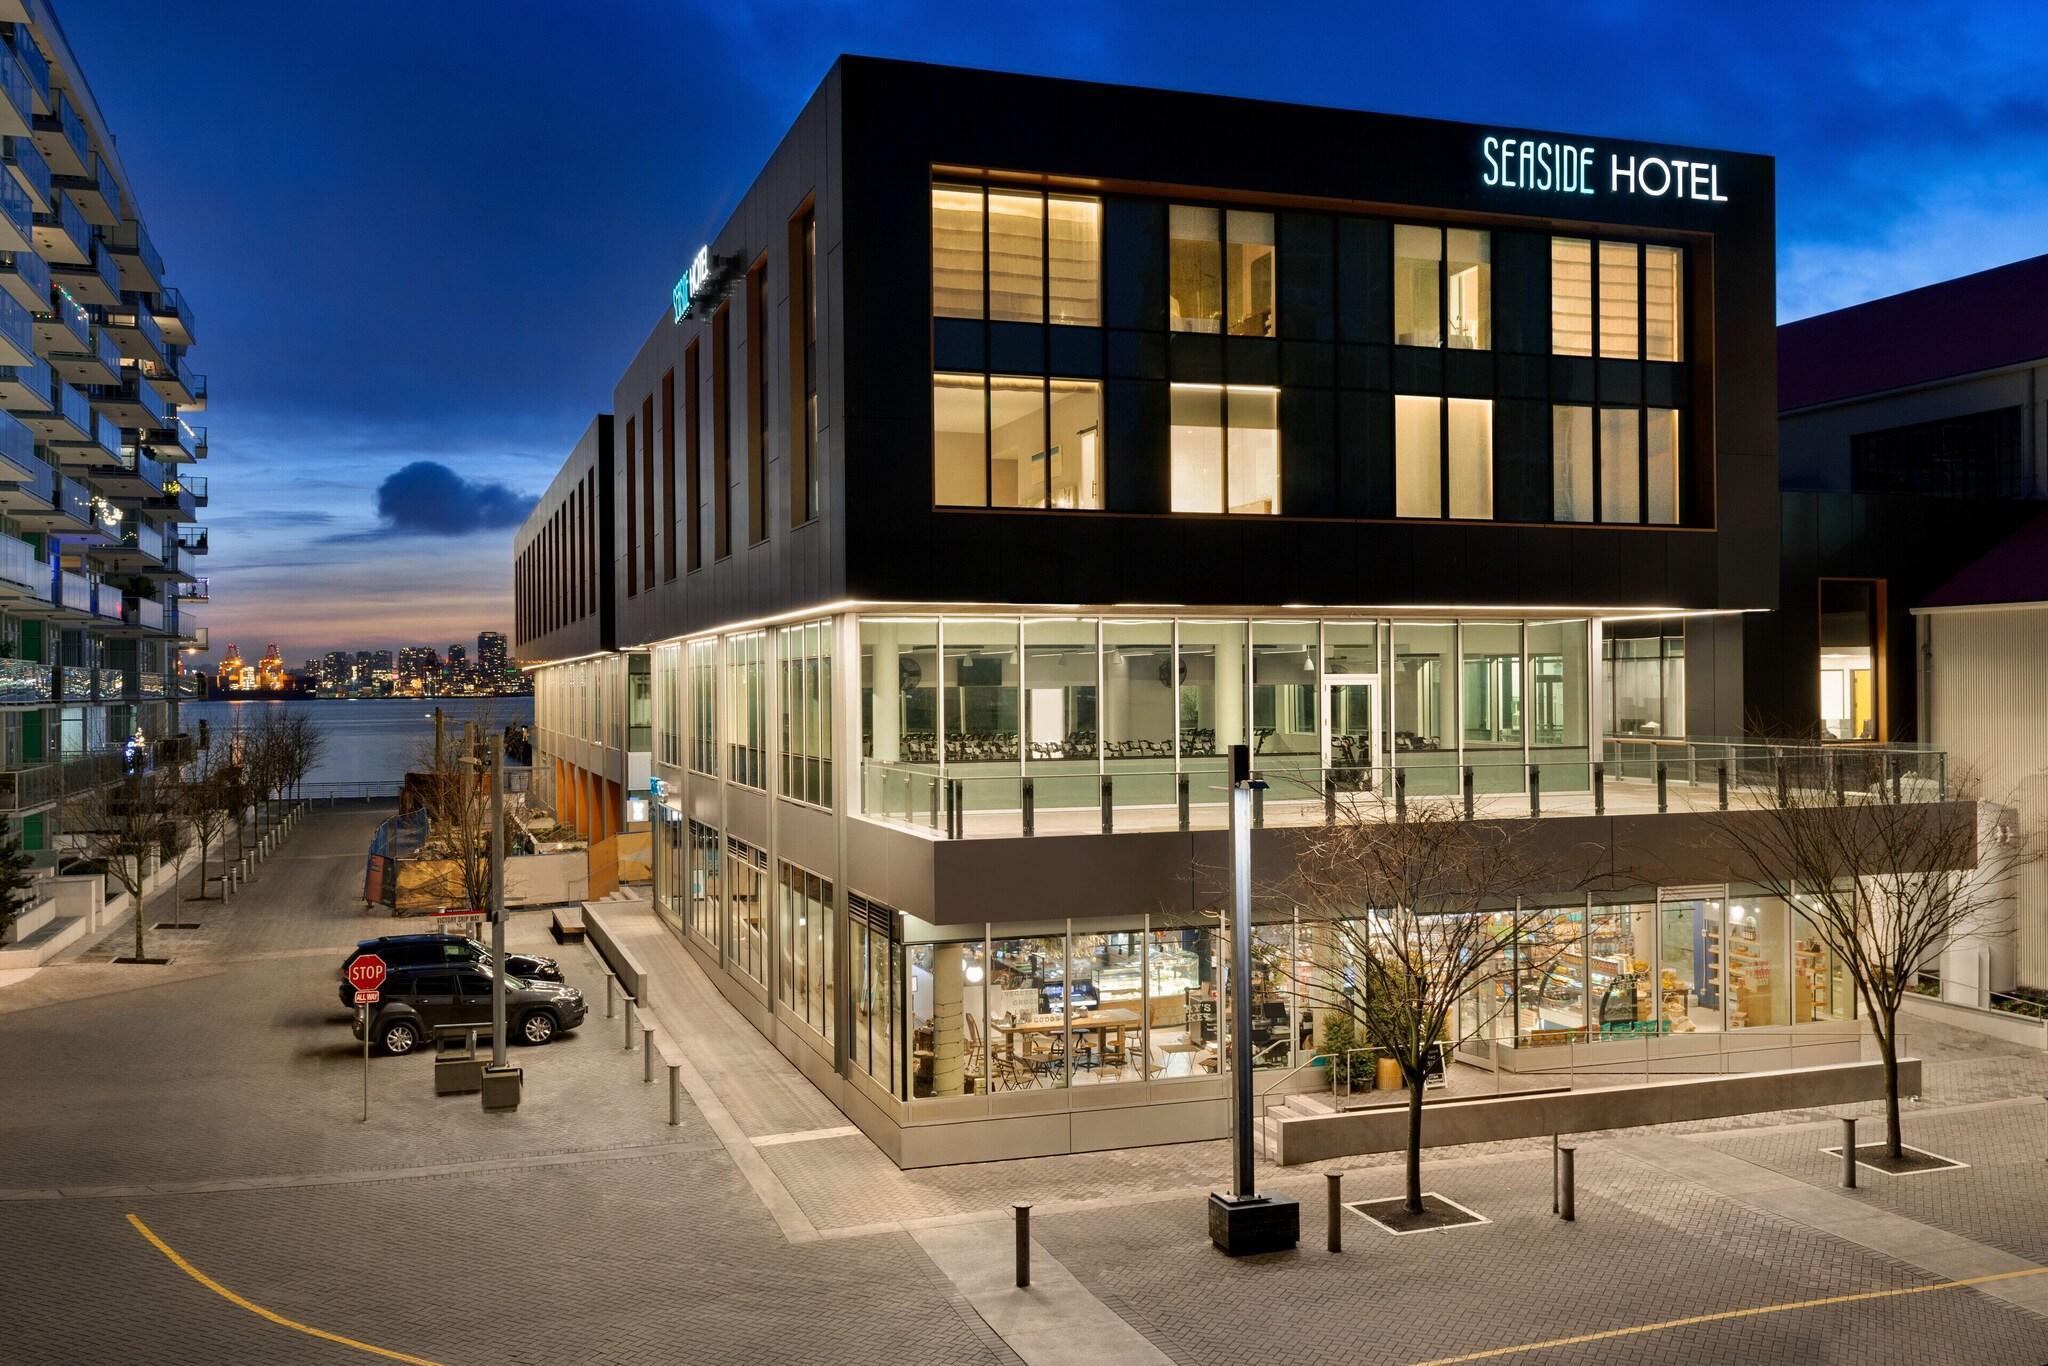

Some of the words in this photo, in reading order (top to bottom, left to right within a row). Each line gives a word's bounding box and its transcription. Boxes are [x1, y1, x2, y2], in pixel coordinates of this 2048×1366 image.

[1483, 136, 1595, 195] SEASIDE
[1610, 153, 1728, 202] HOTEL
[352, 965, 383, 981] STOP
[356, 993, 366, 1001] ALL
[367, 993, 378, 1001] WAY
